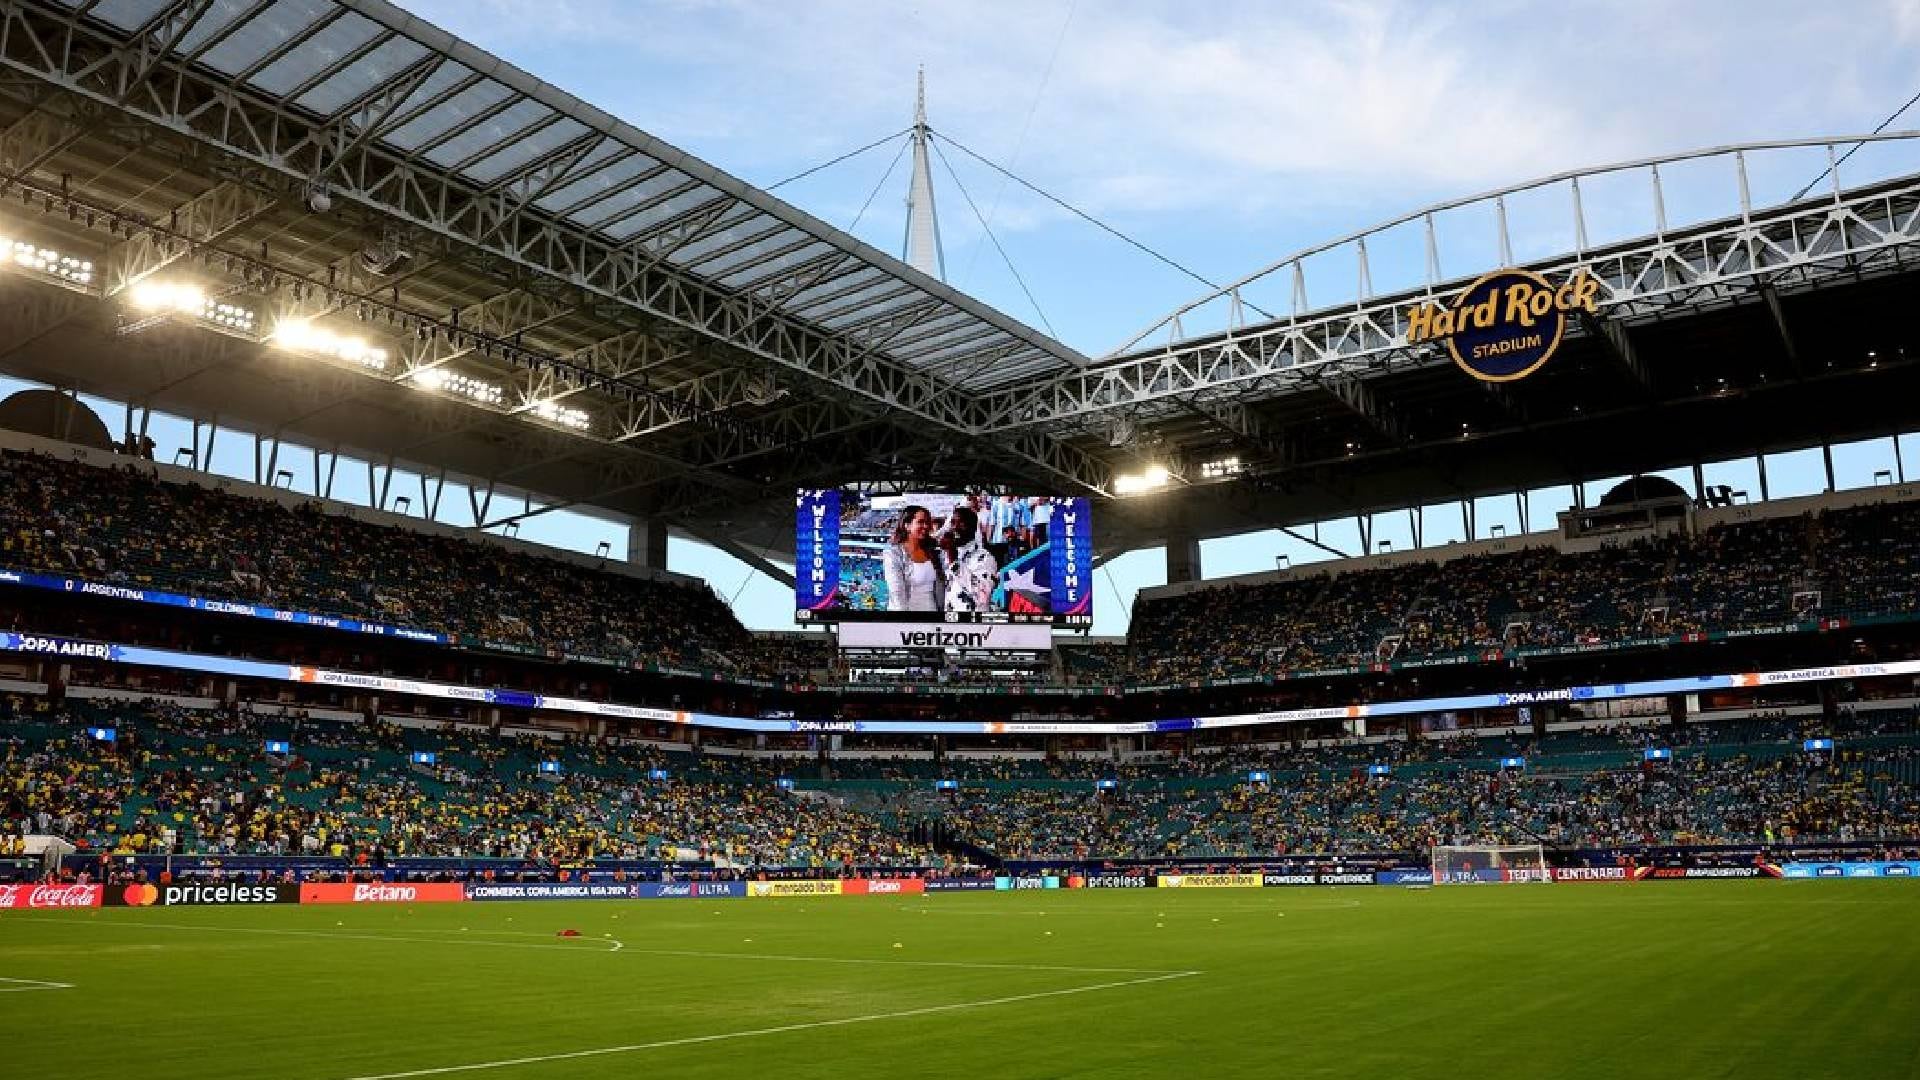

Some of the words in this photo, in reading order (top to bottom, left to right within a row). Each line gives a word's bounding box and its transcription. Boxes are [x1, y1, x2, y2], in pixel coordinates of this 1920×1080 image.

[1407, 289, 1498, 342] Hard
[1505, 270, 1601, 328] Rock
[1472, 334, 1542, 359] STADIUM
[812, 505, 826, 597] WELCOME
[1063, 512, 1077, 603] WELCOME
[81, 582, 144, 601] ARGENTINA
[205, 601, 256, 616] COLOMBIA
[901, 627, 983, 647] verizon
[1556, 867, 1626, 881] CENTENARIO
[165, 885, 278, 906] priceless
[353, 884, 416, 902] Betano
[475, 884, 526, 897] CONMEBOL
[528, 885, 552, 897] COPA
[698, 884, 730, 897] ULTRA
